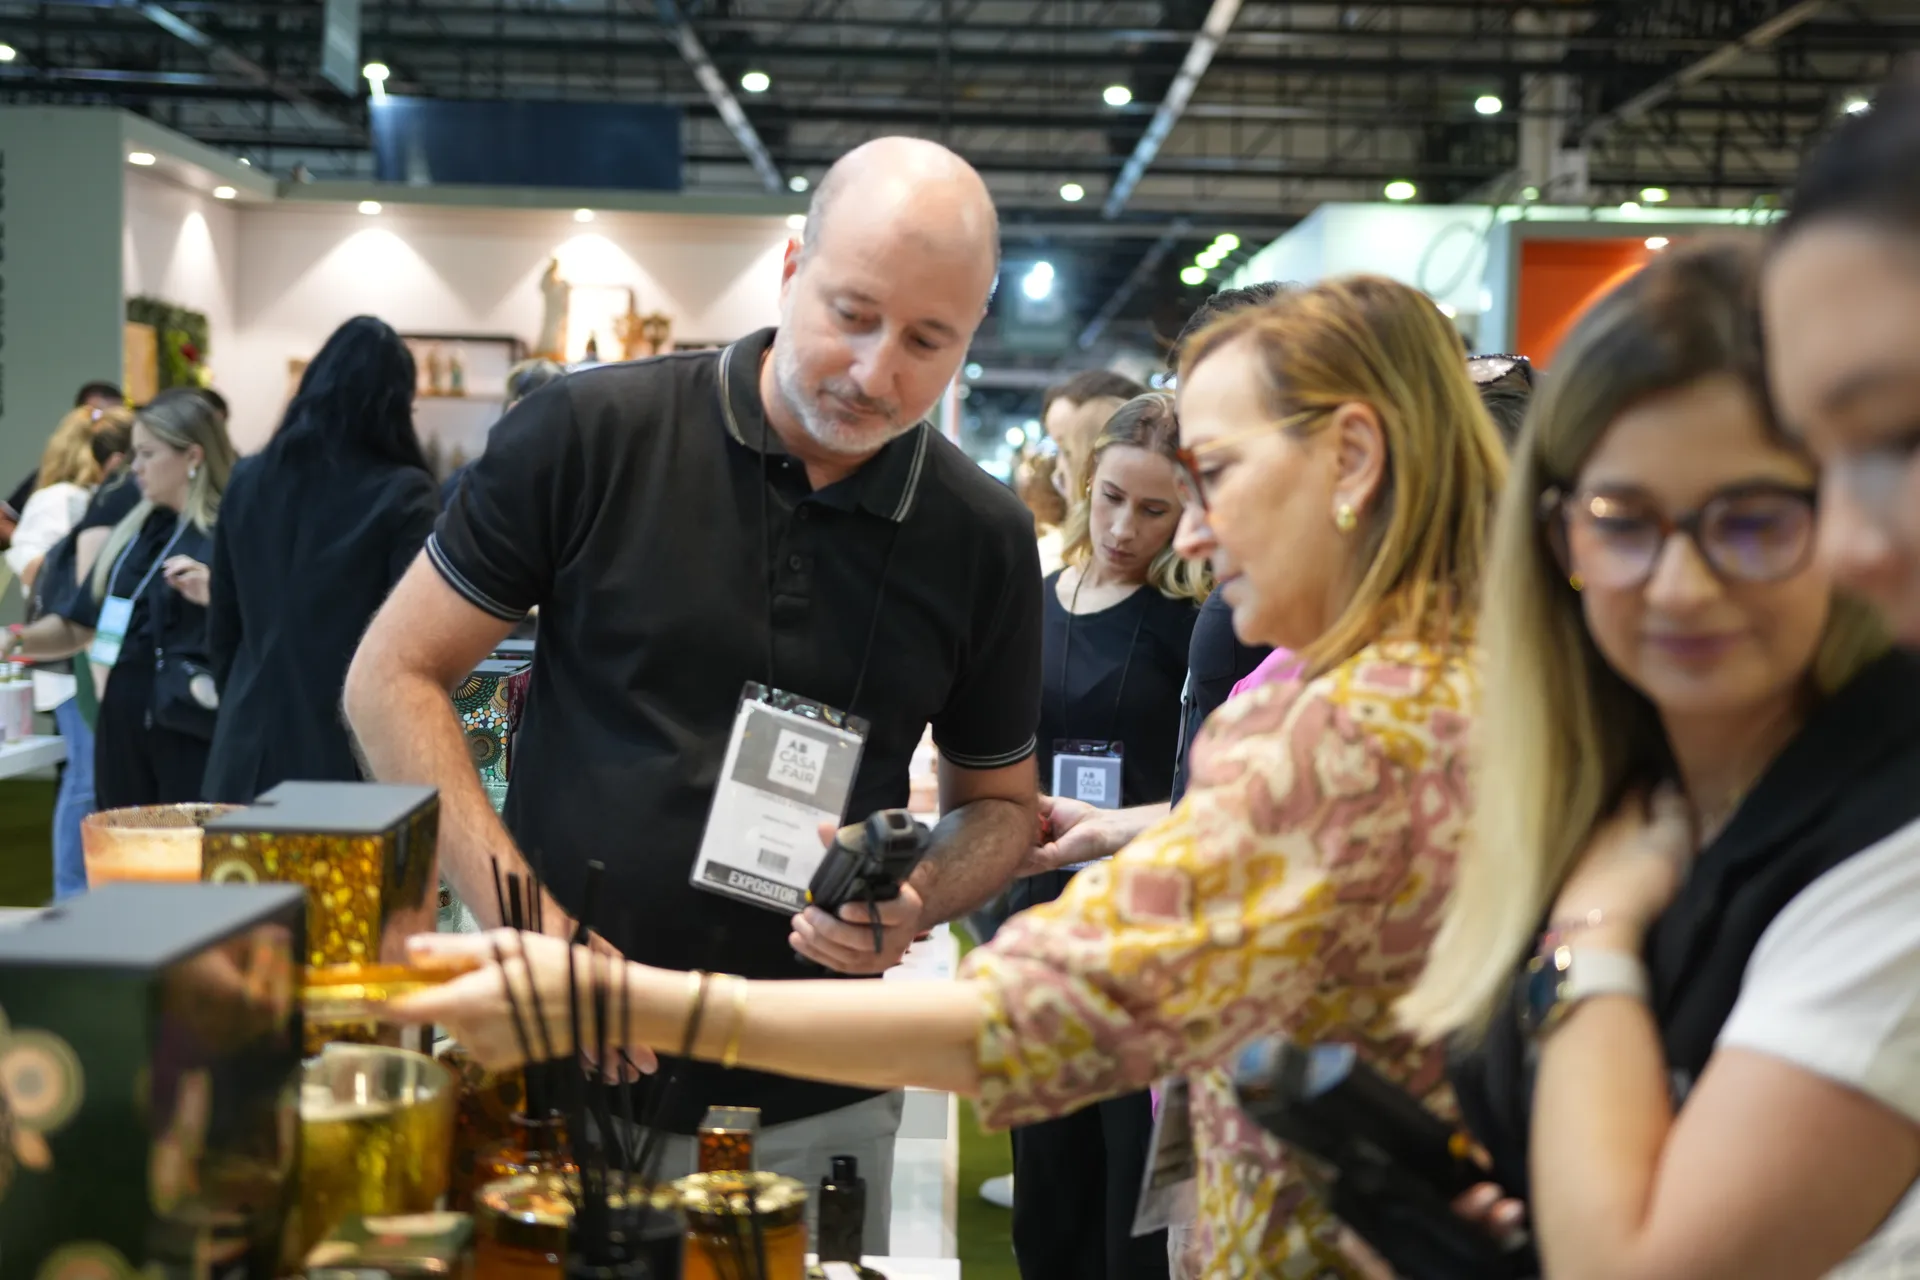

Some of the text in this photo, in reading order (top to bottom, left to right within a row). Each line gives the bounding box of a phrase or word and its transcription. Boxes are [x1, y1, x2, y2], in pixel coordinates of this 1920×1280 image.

[787, 740, 808, 754] AB
[779, 750, 816, 772] CASA
[728, 869, 798, 904] EXPOSITOR
